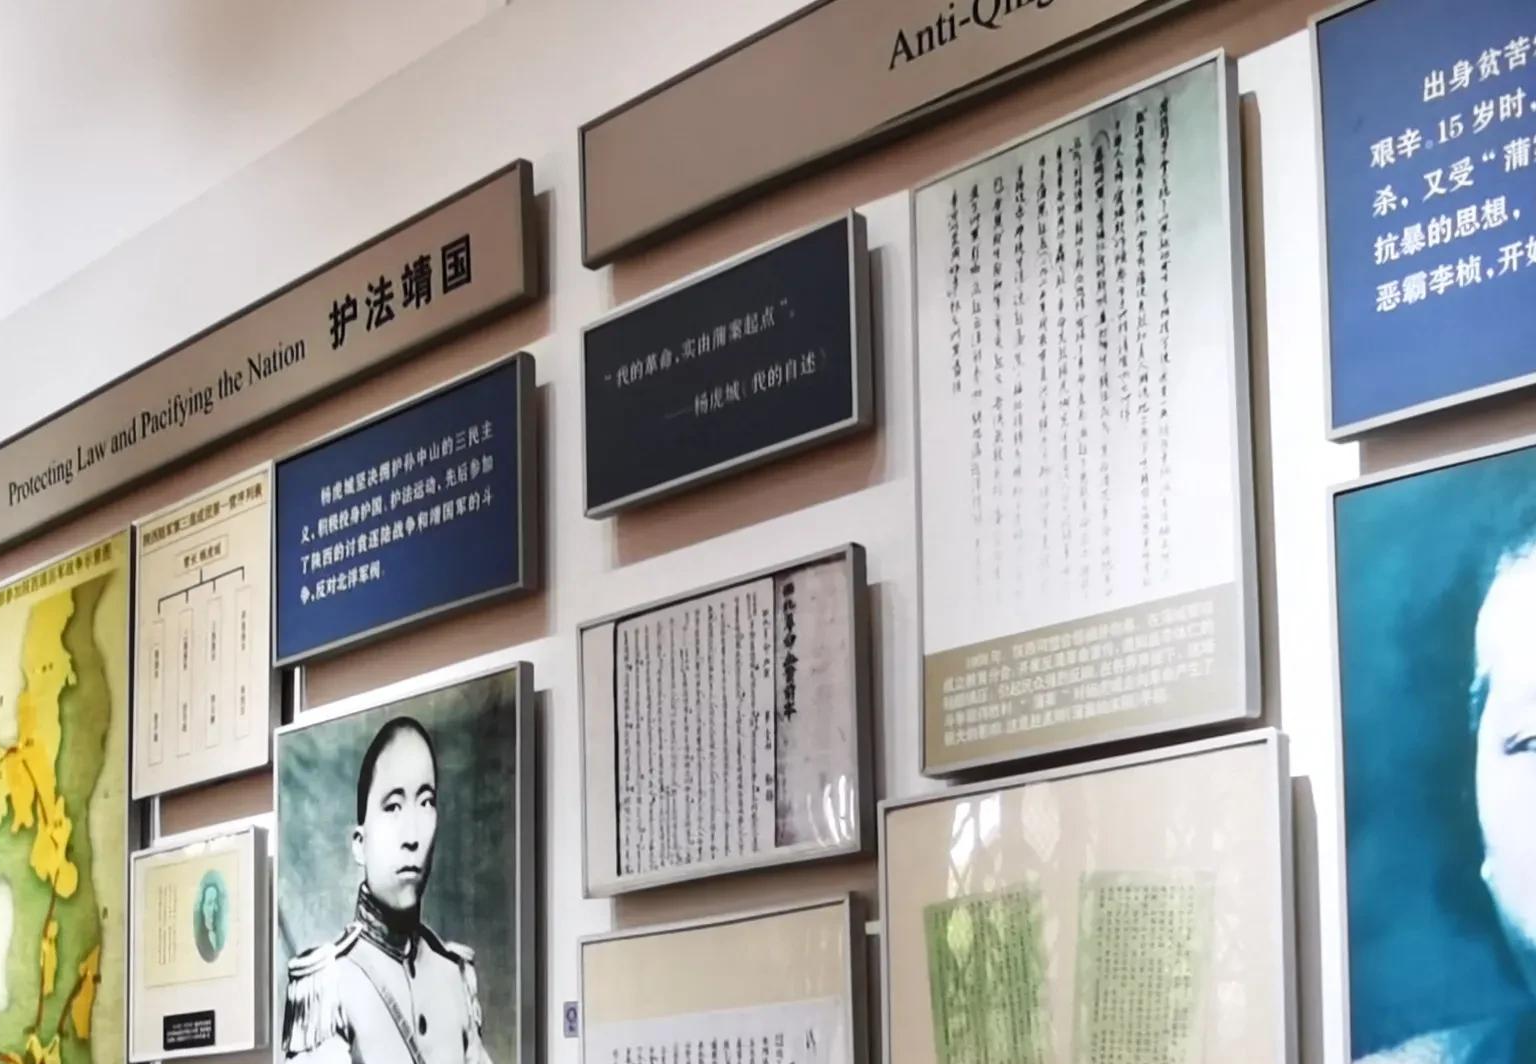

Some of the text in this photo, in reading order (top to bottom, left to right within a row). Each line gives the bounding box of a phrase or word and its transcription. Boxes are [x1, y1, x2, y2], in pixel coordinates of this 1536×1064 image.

[9, 234, 471, 506] Protecting Law and Pacifying the Nation 护法靖国
